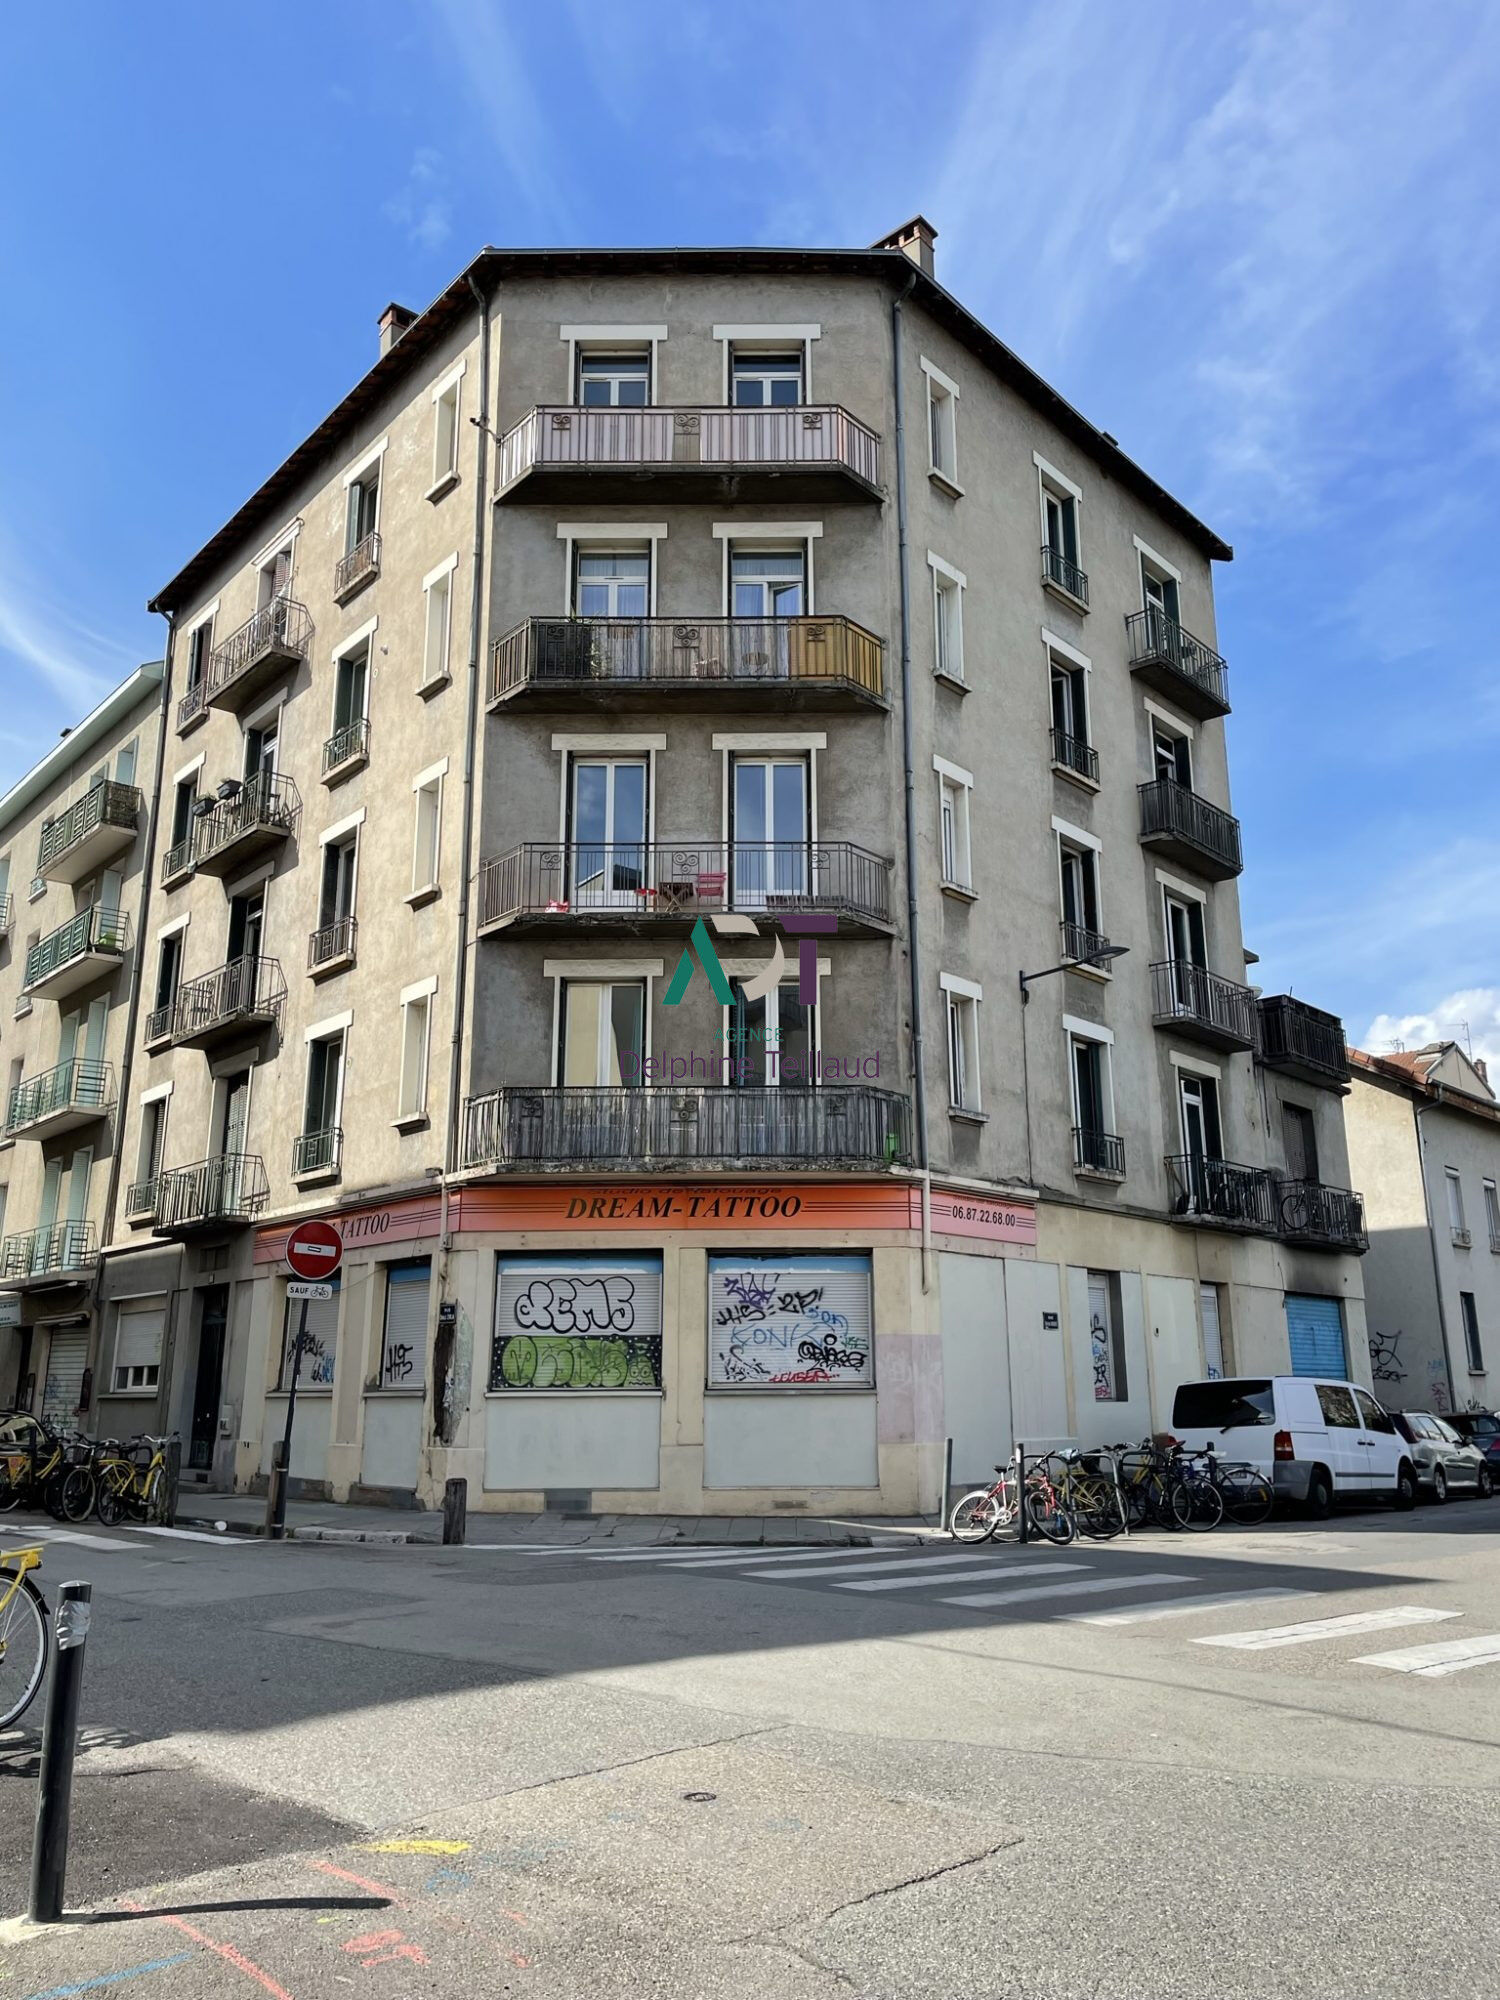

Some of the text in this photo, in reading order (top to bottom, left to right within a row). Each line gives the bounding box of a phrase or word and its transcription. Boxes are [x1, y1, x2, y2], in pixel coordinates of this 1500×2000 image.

[565, 1195, 802, 1219] DREAM-TATTOO
[952, 1205, 1016, 1227] 06.87.22.68.00
[289, 1286, 310, 1295] SAUF
